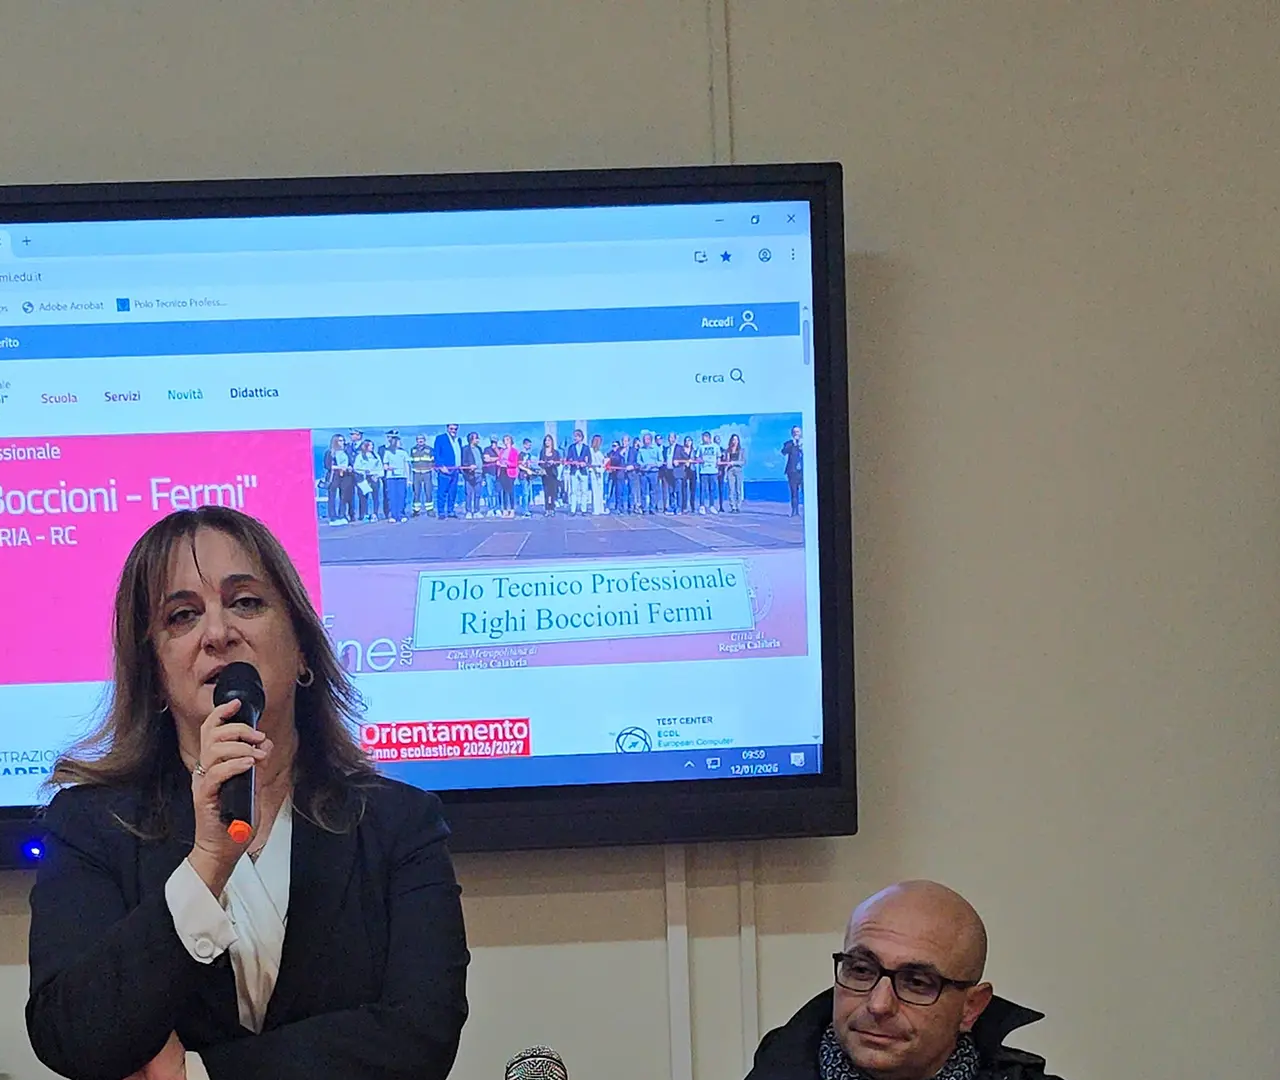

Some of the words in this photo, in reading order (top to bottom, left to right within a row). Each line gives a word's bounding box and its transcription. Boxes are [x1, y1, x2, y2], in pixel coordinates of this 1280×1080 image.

[38, 302, 68, 311] Adobe
[70, 300, 104, 310] Acrobat
[134, 299, 154, 309] Polo
[156, 298, 188, 308] Tecnico
[702, 316, 734, 327] Accedi
[695, 373, 724, 383] Cerca
[40, 392, 78, 404] Scuola
[104, 390, 141, 402] Servizi
[168, 388, 204, 400] Novità
[230, 387, 280, 399] Didattica
[150, 474, 258, 512] Fermi"
[50, 526, 78, 546] RC
[430, 579, 484, 602] Polo
[492, 575, 583, 598] Tecnico
[590, 568, 738, 595] Professionale
[460, 609, 526, 640] Righi
[536, 604, 640, 632] Boccioni
[648, 600, 713, 625] Fermi
[400, 636, 414, 666] 2024
[746, 639, 781, 650] Calabria
[490, 658, 528, 668] Calabria
[656, 718, 678, 726] TEST
[680, 716, 714, 725] CENTER
[361, 720, 528, 745] Orientamento
[657, 730, 680, 738] ECDL
[658, 738, 694, 748] European
[696, 736, 734, 747] Computer
[400, 743, 461, 758] scolastico
[464, 740, 524, 757] 2026/2027
[730, 764, 779, 776] 12/01/2026
